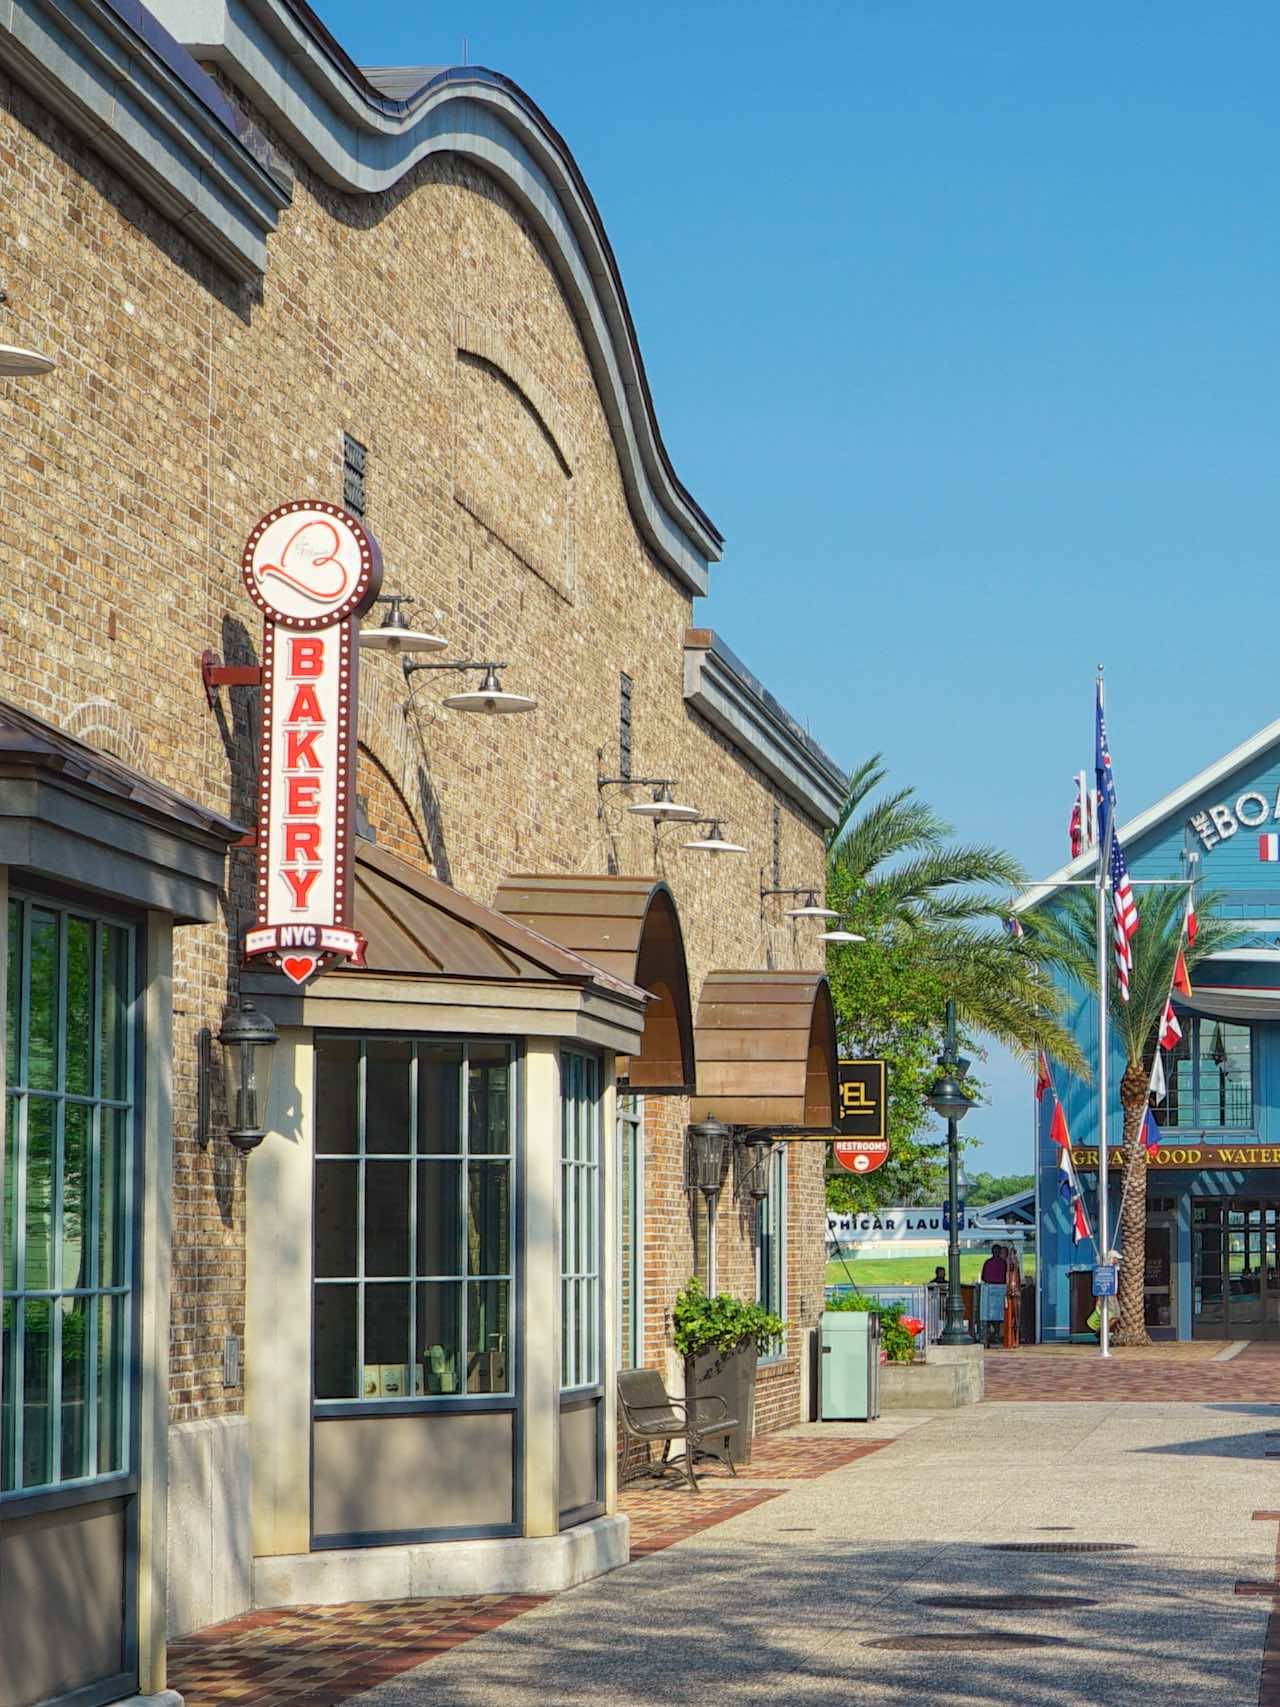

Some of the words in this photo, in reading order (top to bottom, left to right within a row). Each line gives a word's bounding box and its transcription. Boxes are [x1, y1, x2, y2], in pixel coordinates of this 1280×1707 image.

[280, 636, 326, 912] BAKERY
[280, 926, 317, 947] NYC
[839, 1082, 877, 1107] EL
[836, 1142, 887, 1151] RESTROOMS
[1144, 1149, 1202, 1165] FOOD
[906, 1218, 976, 1230] LAUH
